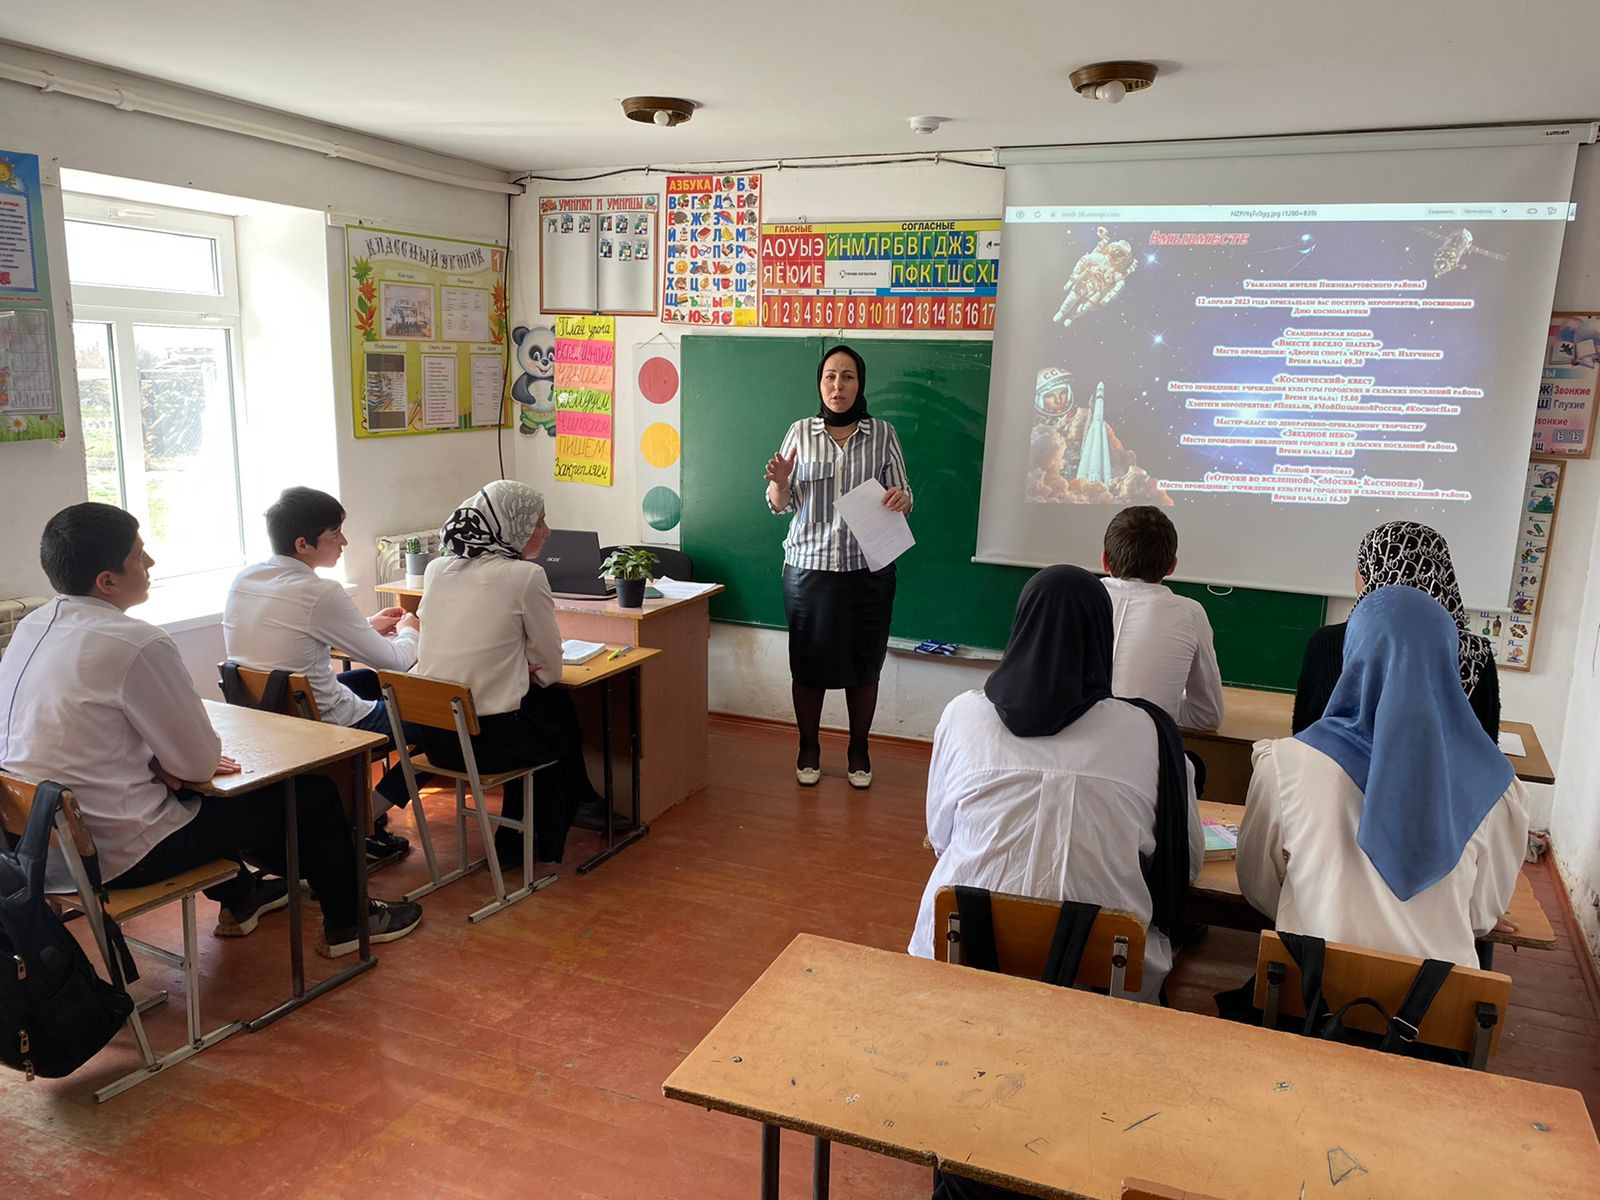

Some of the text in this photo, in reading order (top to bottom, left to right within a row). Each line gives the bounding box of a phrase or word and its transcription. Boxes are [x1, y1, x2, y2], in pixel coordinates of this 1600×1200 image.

[669, 177, 745, 192] АЗБУКА А Б
[559, 197, 643, 211] УМНИКИ И УМНИЦЫ
[669, 196, 677, 210] В
[691, 196, 698, 209] Г
[713, 195, 723, 209] Д
[690, 212, 702, 226] Ж
[901, 222, 955, 231] СОГЛАСНЫЕ
[668, 227, 722, 242] Й К Л
[774, 225, 813, 233] ГЛАСНЫЕ
[366, 236, 438, 269] КЛАССНЫЙ
[763, 302, 995, 326] 0 1 2 3 4 5 6 7 8 9 10 11 12 13 14 15 16 17
[559, 317, 610, 341] План урока
[1554, 385, 1591, 395] Звонкие
[1553, 400, 1585, 411] Глухие
[560, 435, 606, 458] ПИШЕМ
